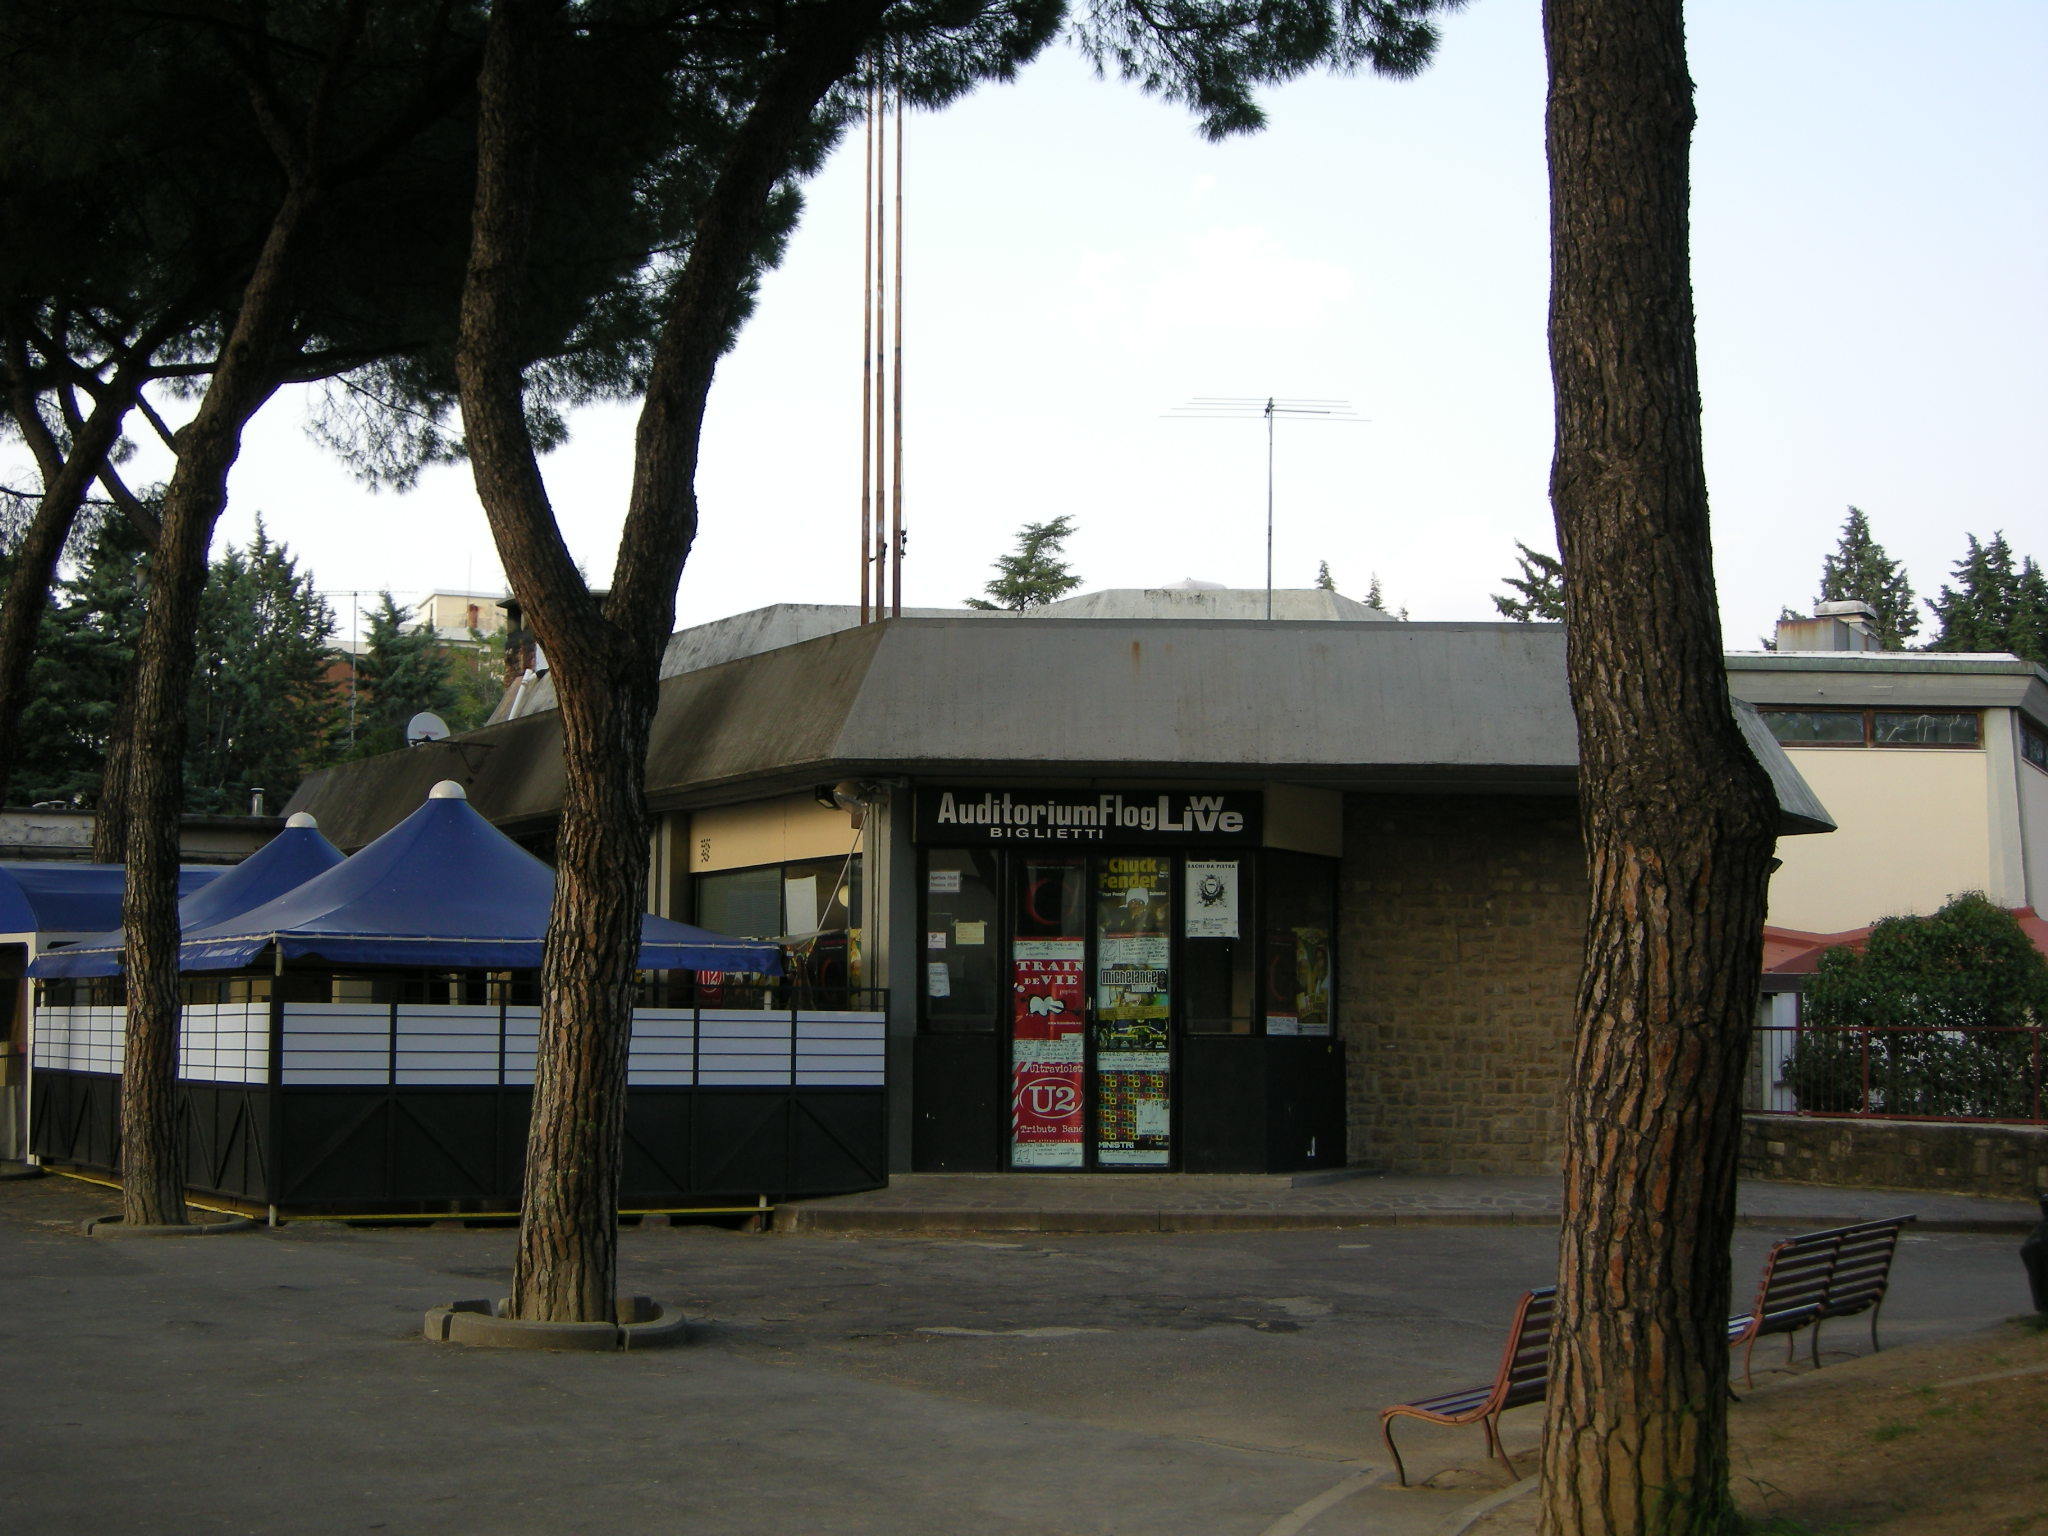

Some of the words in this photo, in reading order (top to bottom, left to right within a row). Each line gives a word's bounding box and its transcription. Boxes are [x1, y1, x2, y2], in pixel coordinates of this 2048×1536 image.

[990, 827, 1104, 839] BIGLIETTI
[1108, 856, 1158, 873] Chuck
[1016, 961, 1084, 971] TRAIN
[1028, 1086, 1076, 1113] U2
[1020, 1125, 1057, 1134] Tribute
[1062, 1125, 1083, 1134] Band
